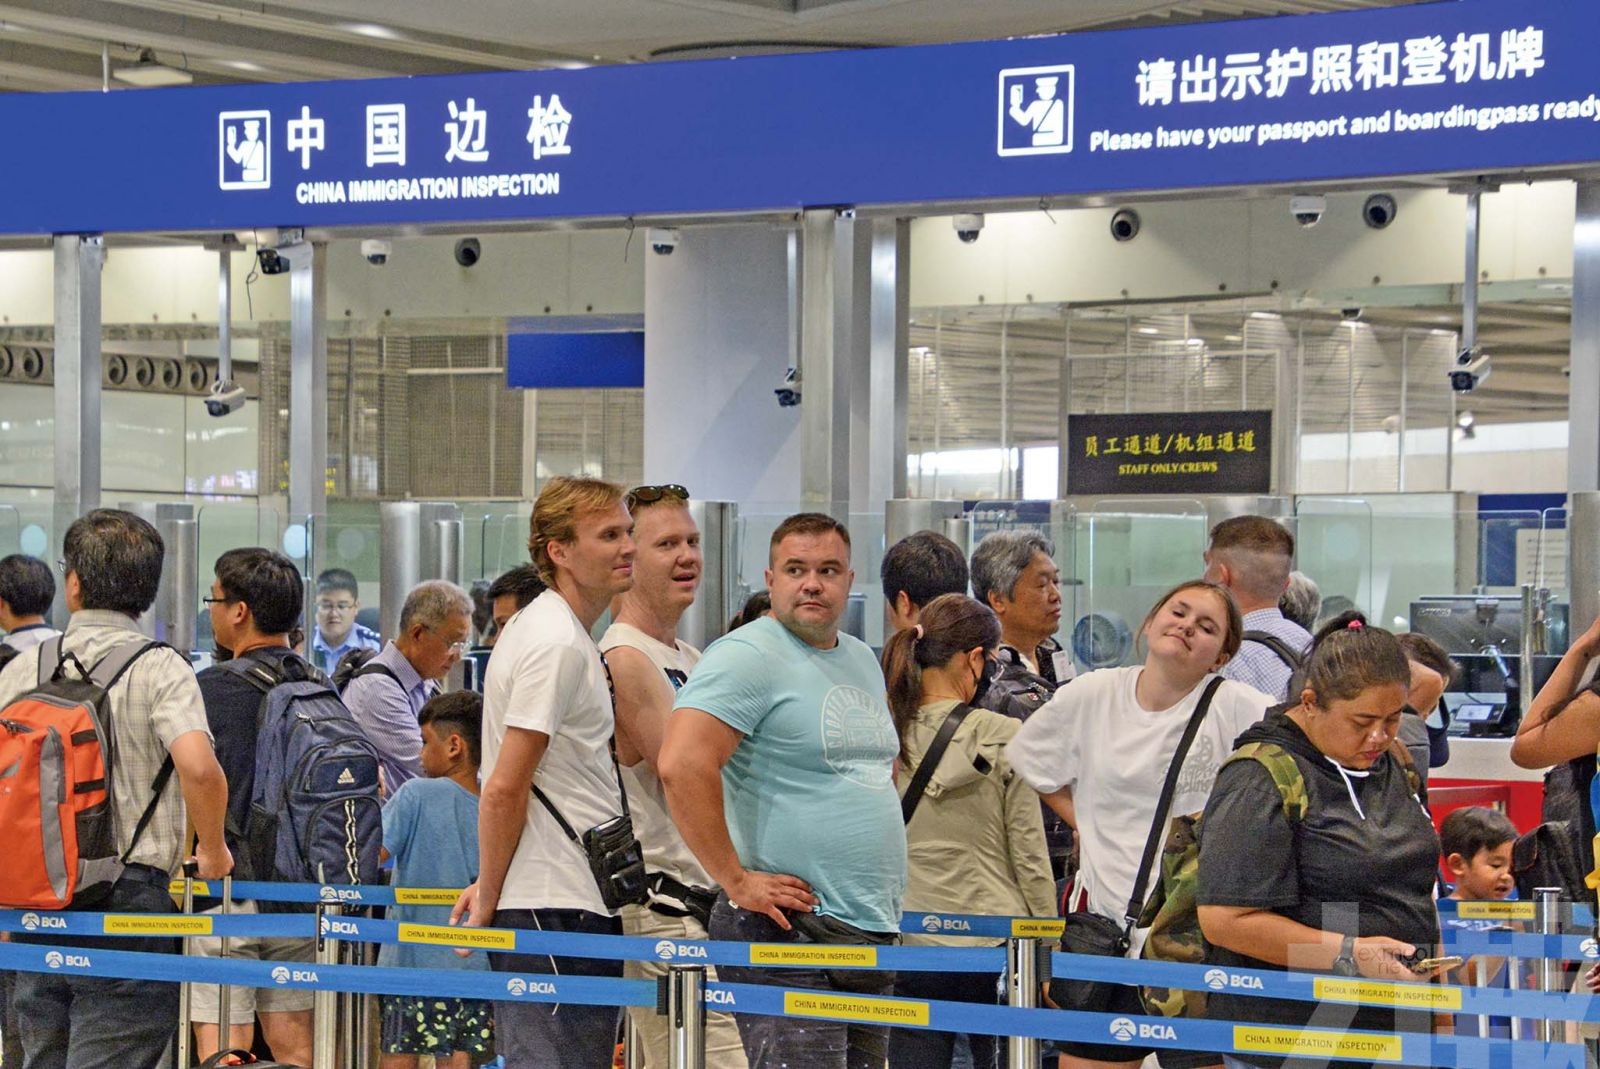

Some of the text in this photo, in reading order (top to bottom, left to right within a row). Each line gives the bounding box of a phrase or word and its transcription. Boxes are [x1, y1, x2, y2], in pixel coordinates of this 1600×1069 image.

[1135, 25, 1545, 106] 请出示护照和登机牌
[287, 93, 573, 170] 中国边检
[1089, 129, 1153, 152] Please
[1156, 126, 1205, 148] have
[1207, 124, 1256, 150] your
[1257, 115, 1348, 146] passport
[1349, 110, 1391, 135] and
[1393, 103, 1540, 131] boardingpass
[295, 172, 560, 205] CHINA IMMIGRATION INSPECTION
[1085, 429, 1257, 457] 员工通道/机组通道
[1118, 463, 1149, 475] STAFF
[337, 889, 362, 900] BCIA
[41, 916, 67, 929] BCIA
[331, 921, 359, 935] BCIA
[943, 919, 971, 931] BCIA
[406, 930, 505, 943] CHINA IMMIGRATION INSPECTION
[677, 944, 708, 958] BCIA
[759, 951, 866, 961] CHINA IMMIGRATION INSPECTION
[65, 955, 91, 968] BCIA
[292, 970, 319, 983] BCIA
[1230, 974, 1264, 991] BCIA
[528, 982, 557, 995] BCIA
[1323, 985, 1449, 1002] CHINA IMMIGRATION INSPECTION
[704, 989, 736, 1005] BCIA
[794, 1000, 917, 1017] CHINA IMMIGRATION INSPECTION
[1139, 1024, 1178, 1041] BCIA
[1245, 1034, 1387, 1052] CHINA IMMIGRATION INSPECTION
